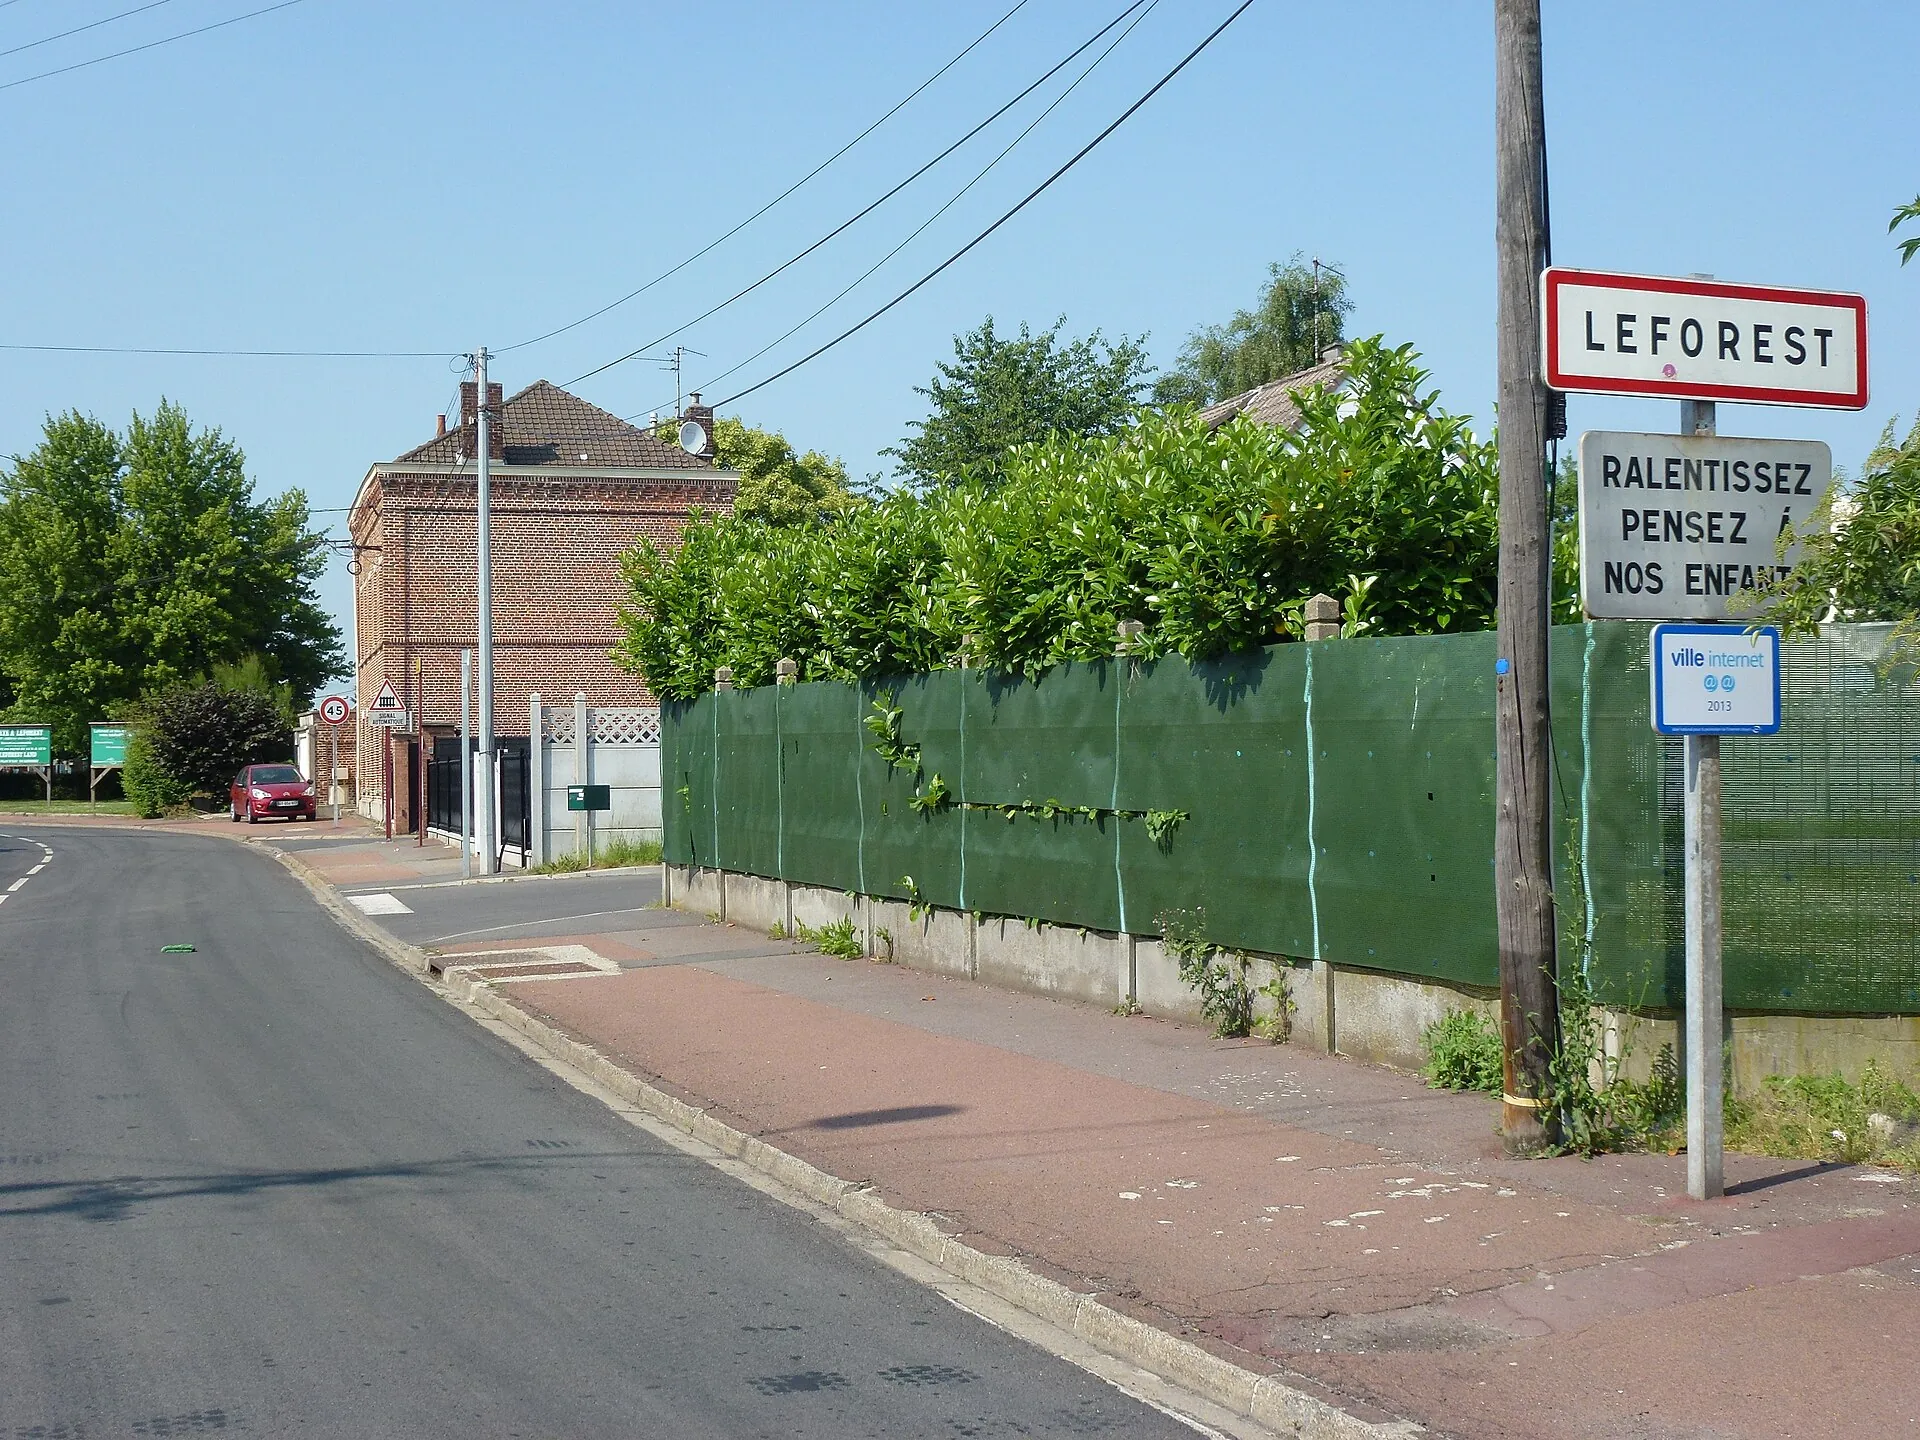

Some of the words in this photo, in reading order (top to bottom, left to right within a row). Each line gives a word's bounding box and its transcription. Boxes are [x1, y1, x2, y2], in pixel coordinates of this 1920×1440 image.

[1585, 310, 1834, 367] LEFOREST
[1602, 455, 1812, 496] RALENTISSEZ
[1621, 508, 1748, 545] PENSEZ
[1604, 561, 1664, 595] NOS
[1685, 563, 1808, 597] ENFANT
[1671, 648, 1705, 667] ville
[1708, 650, 1765, 668] internet
[326, 705, 343, 716] 45
[1707, 700, 1732, 712] 2013
